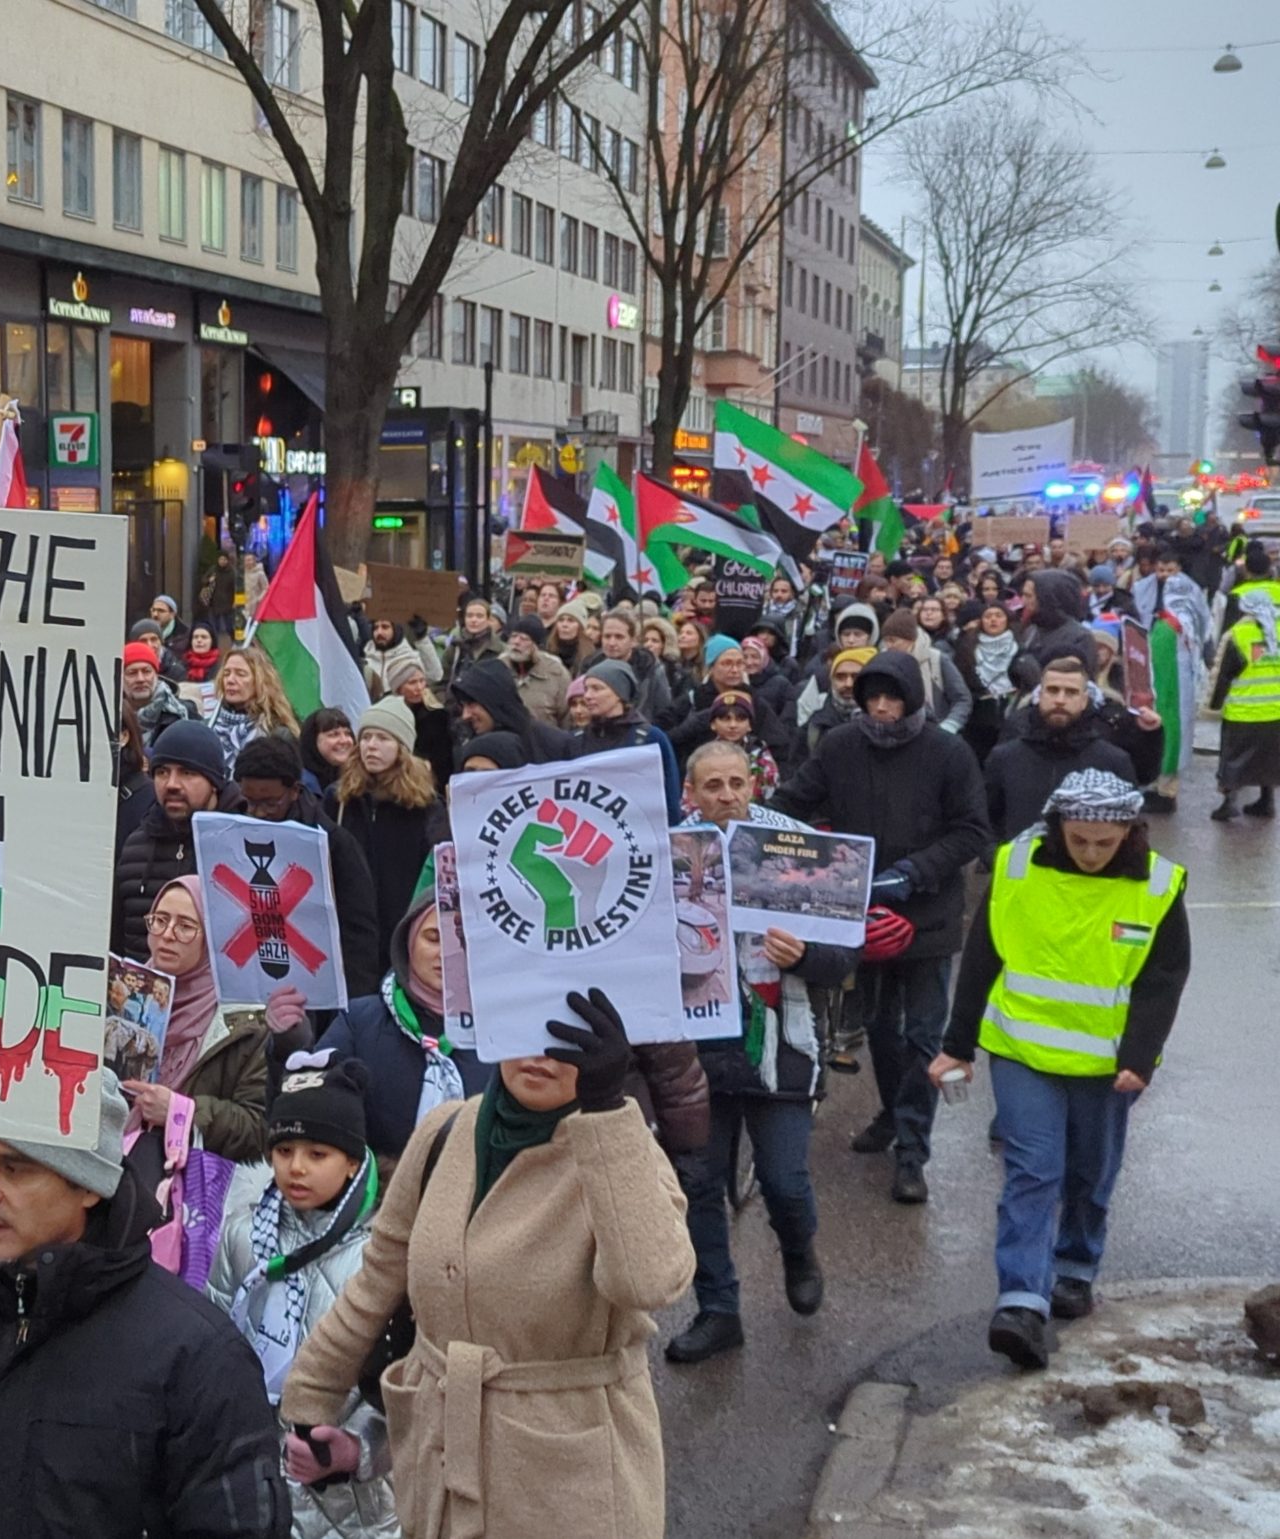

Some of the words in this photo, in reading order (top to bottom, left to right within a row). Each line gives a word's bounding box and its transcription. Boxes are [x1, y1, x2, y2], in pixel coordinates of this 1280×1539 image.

[715, 580, 765, 600] CHILDREN
[478, 785, 540, 847] FREE
[554, 778, 629, 820] GAZA
[777, 833, 806, 845] GAZA
[763, 843, 796, 857] UNDER
[797, 847, 819, 860] FIRE
[249, 889, 282, 911] STOP
[479, 885, 536, 945] FREE
[546, 853, 653, 952] PALESTINE
[252, 912, 286, 927] BOM
[257, 941, 290, 960] GAZA
